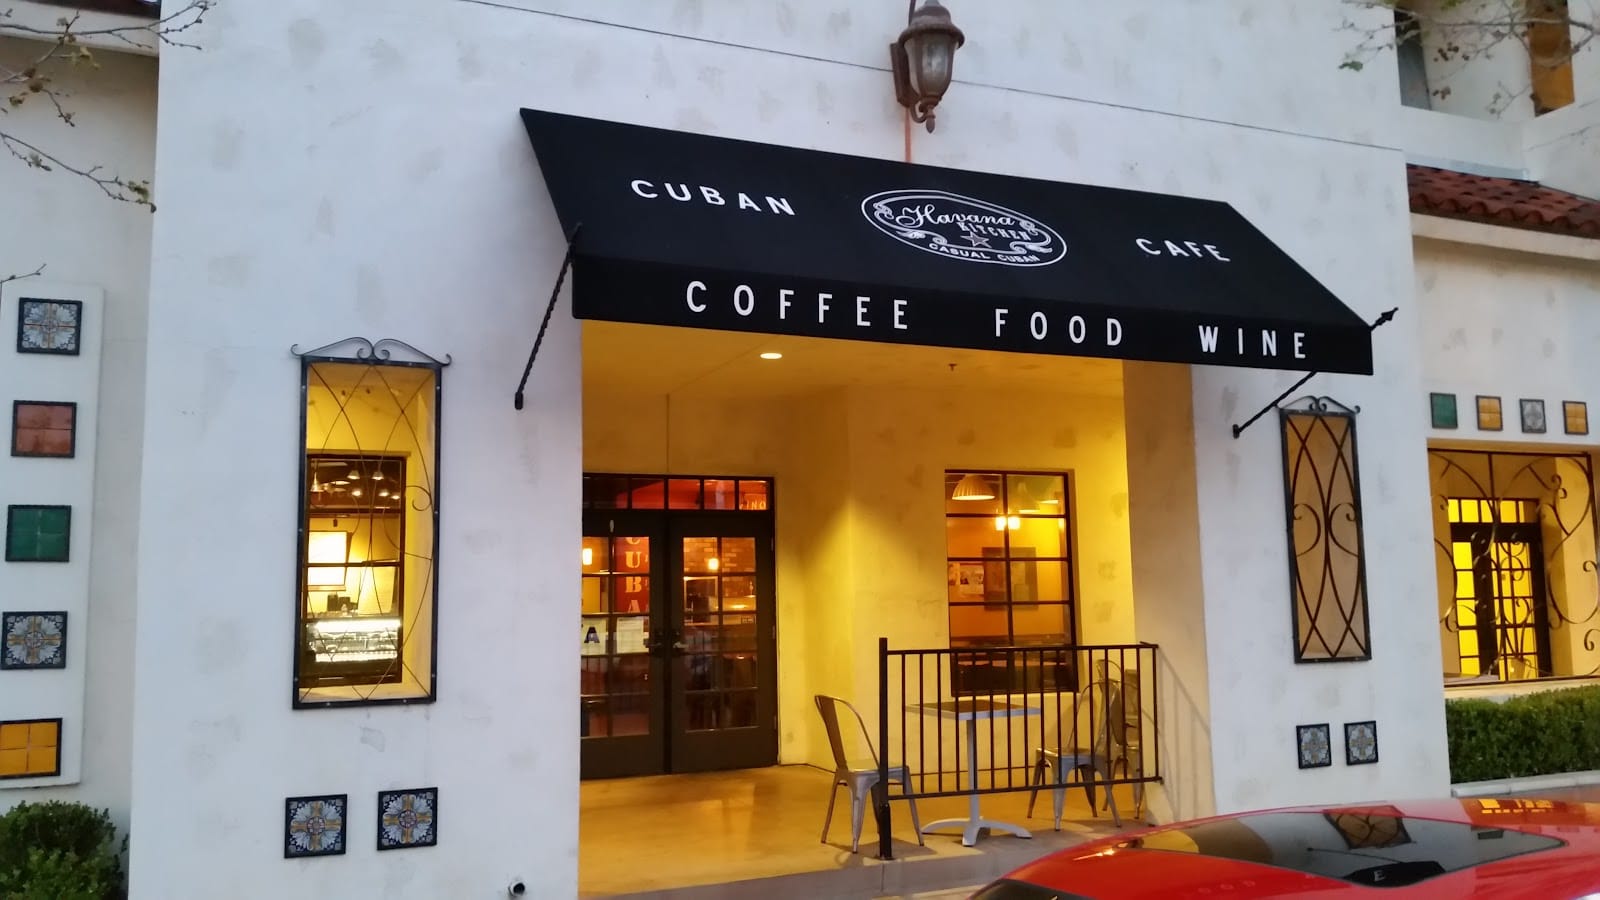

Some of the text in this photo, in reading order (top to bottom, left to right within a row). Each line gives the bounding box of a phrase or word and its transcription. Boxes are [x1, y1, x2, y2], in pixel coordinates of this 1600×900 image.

[631, 179, 795, 215] CUBAN
[896, 204, 1015, 228] Havana
[957, 221, 1031, 241] KITCHEN
[929, 243, 1040, 263] CASUAL CUBAN
[1136, 238, 1230, 262] CAFE
[686, 280, 1306, 358] COFFEE FOOD WINE
